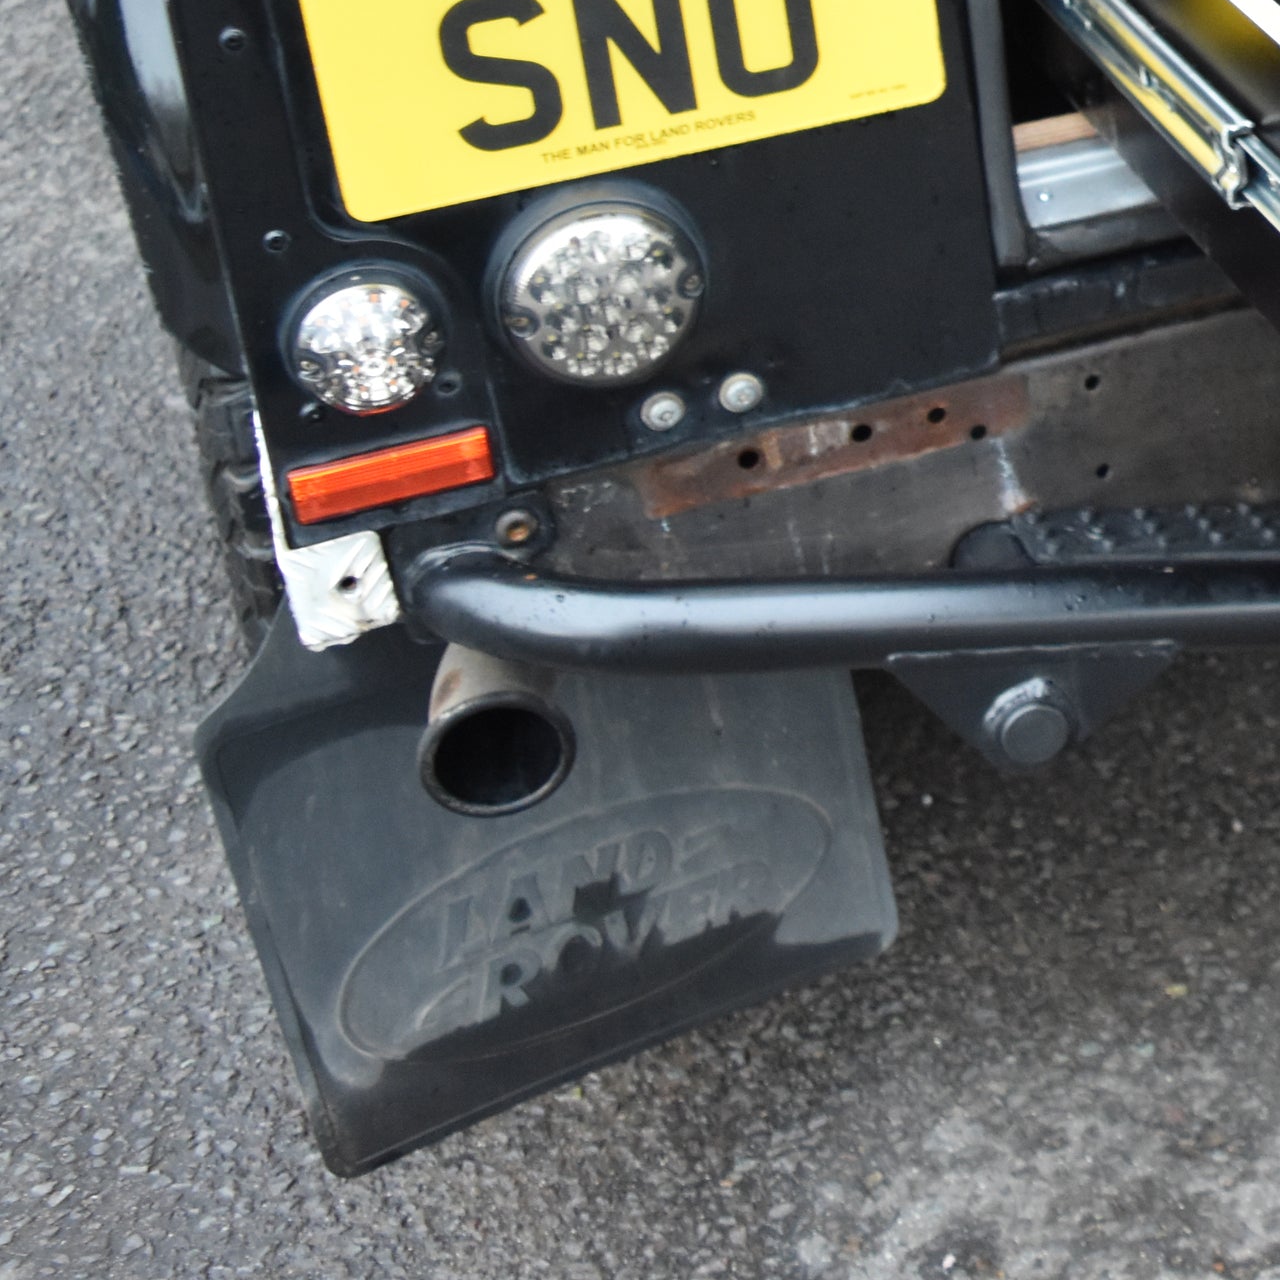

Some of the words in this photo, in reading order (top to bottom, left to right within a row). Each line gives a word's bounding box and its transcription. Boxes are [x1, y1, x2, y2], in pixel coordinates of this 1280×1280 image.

[541, 149, 572, 164] THE
[576, 141, 610, 157] MAN
[614, 133, 645, 148] FOR
[649, 123, 691, 141] LAND
[694, 110, 757, 132] ROVERS
[437, 830, 673, 972] LAND
[476, 862, 773, 1024] ROVER
